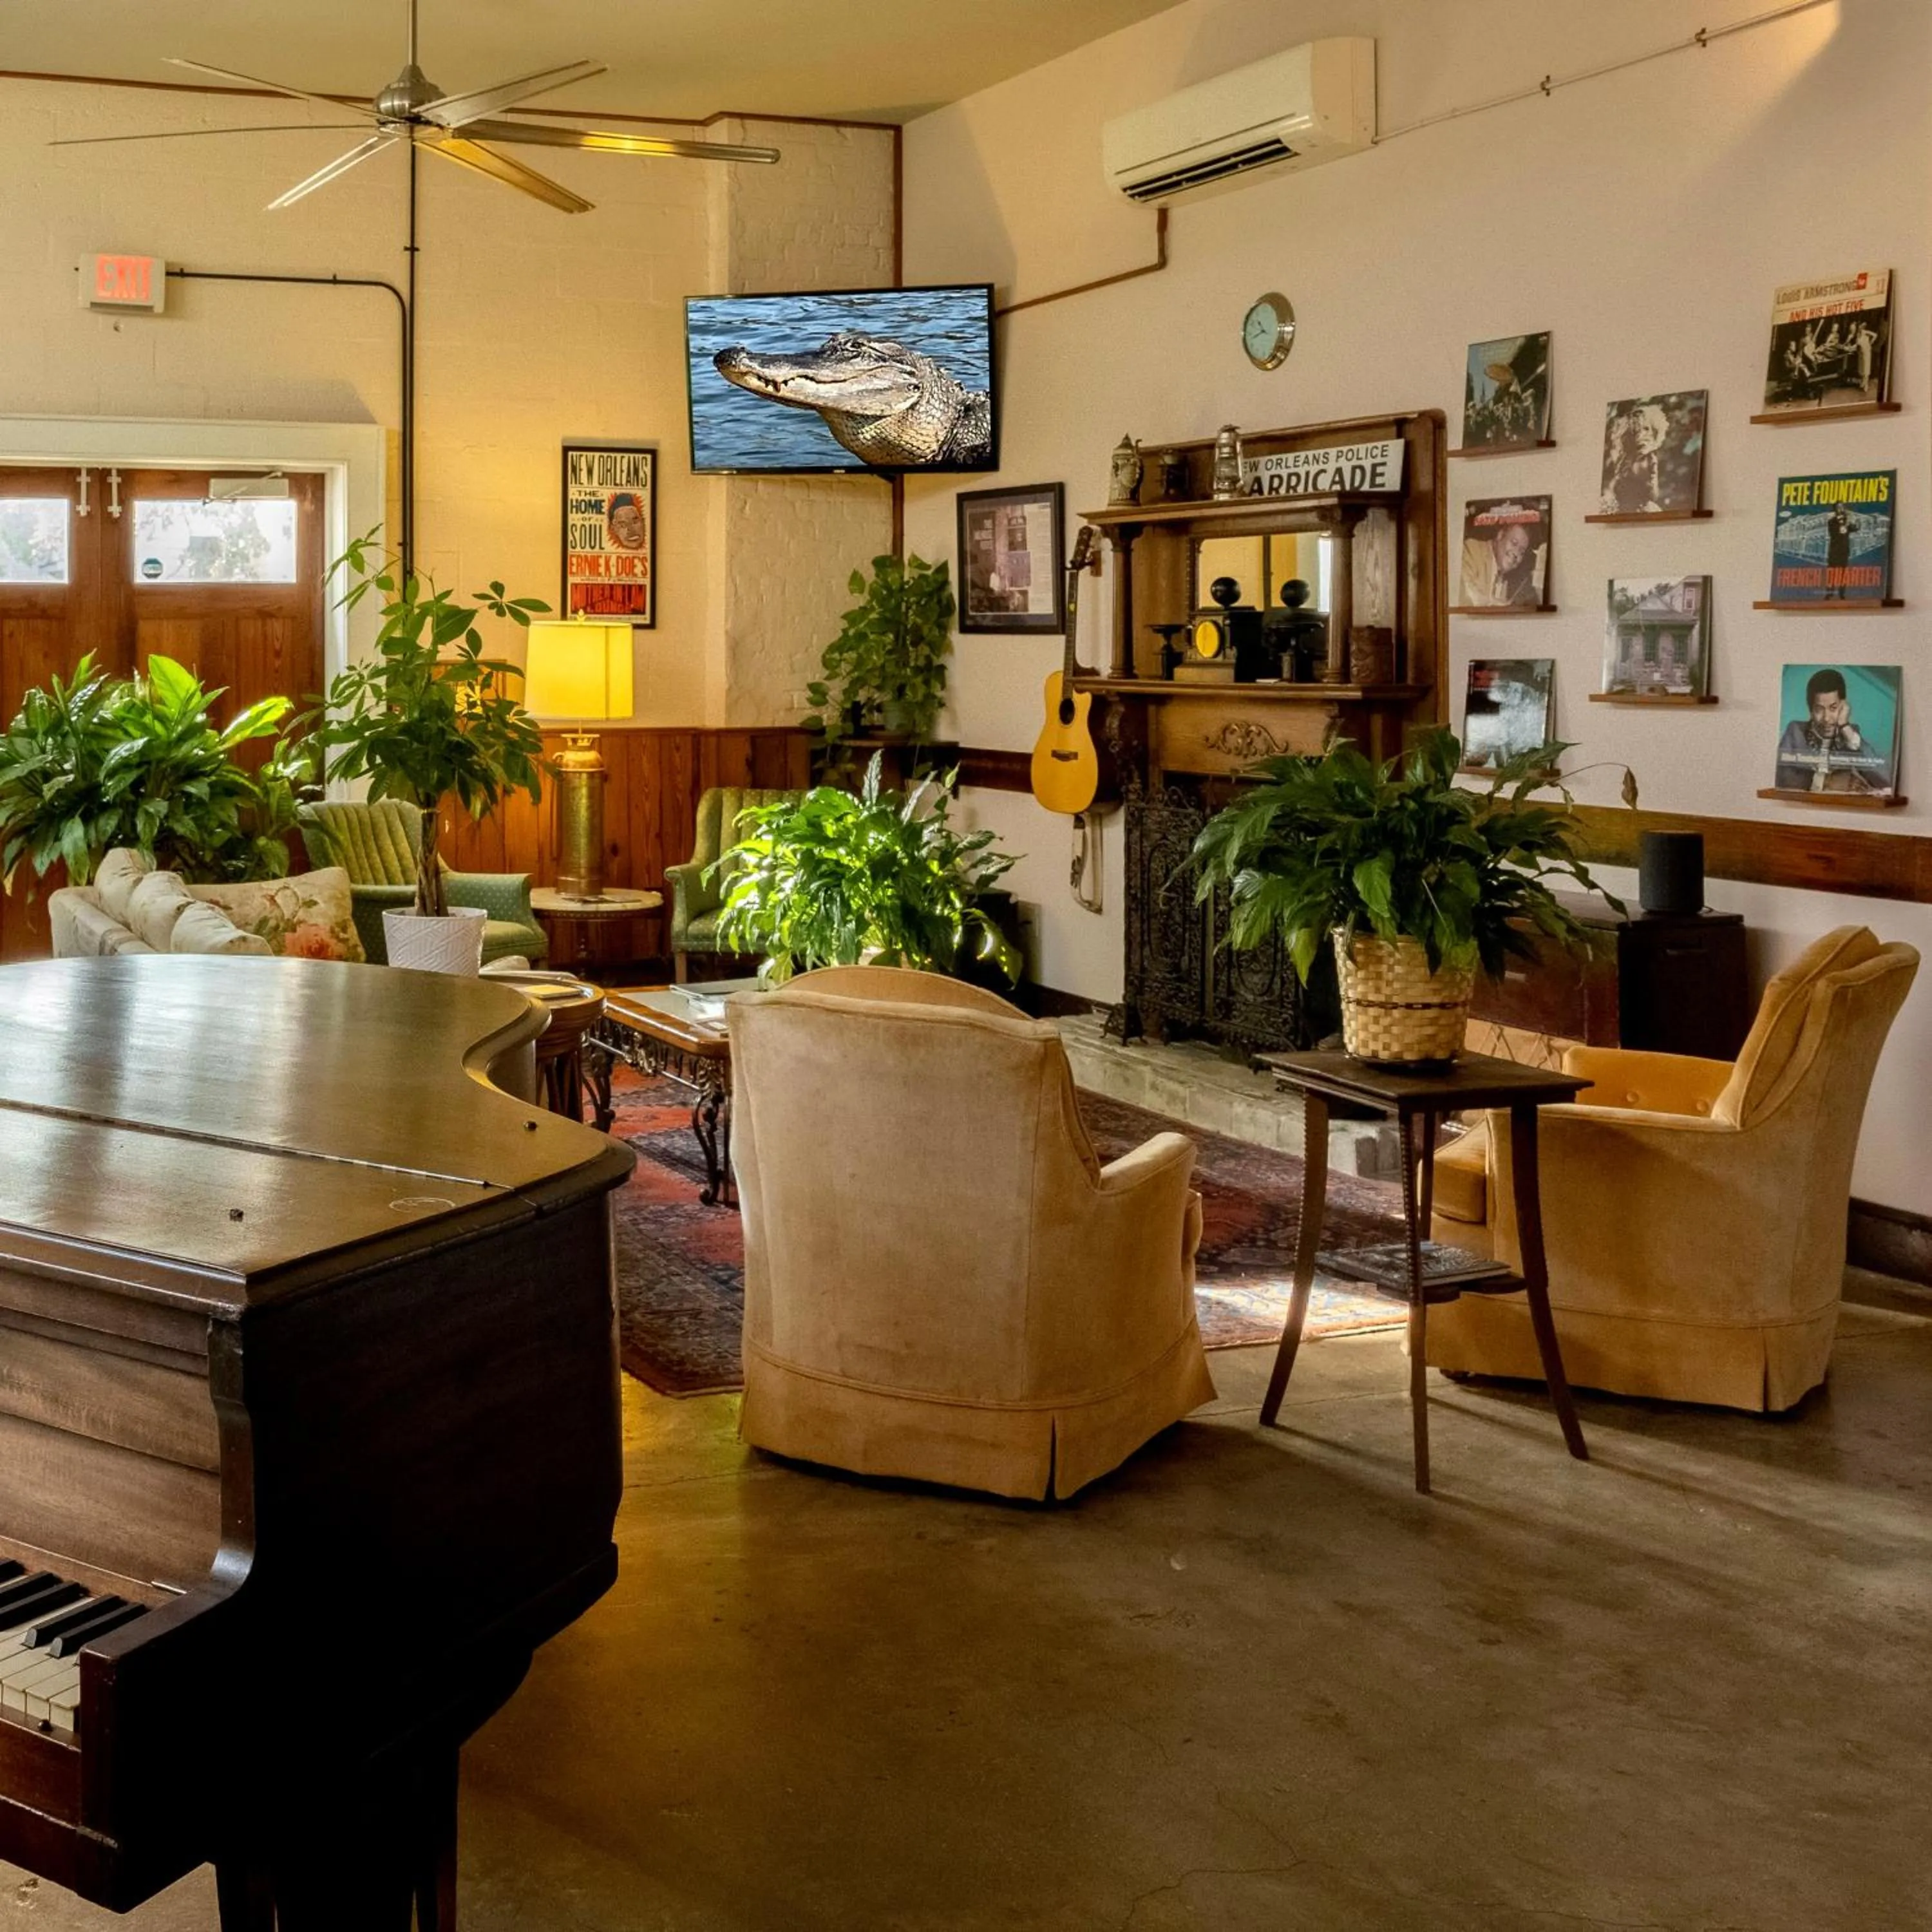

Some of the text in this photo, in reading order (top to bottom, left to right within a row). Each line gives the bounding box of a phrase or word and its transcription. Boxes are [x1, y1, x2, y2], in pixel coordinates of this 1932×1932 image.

[97, 256, 153, 301] EXIT
[570, 453, 648, 488] NEW ORLEANS
[1242, 444, 1389, 475] EW ORLEANS POLICE
[1248, 461, 1388, 496] ARRICADE
[1782, 476, 1889, 506] PETE FOUNTAIN'S
[570, 498, 607, 515] HOME
[570, 523, 605, 550] SOUL
[569, 554, 603, 577] ERNIE
[1777, 566, 1882, 588] FRENCH QUARTER
